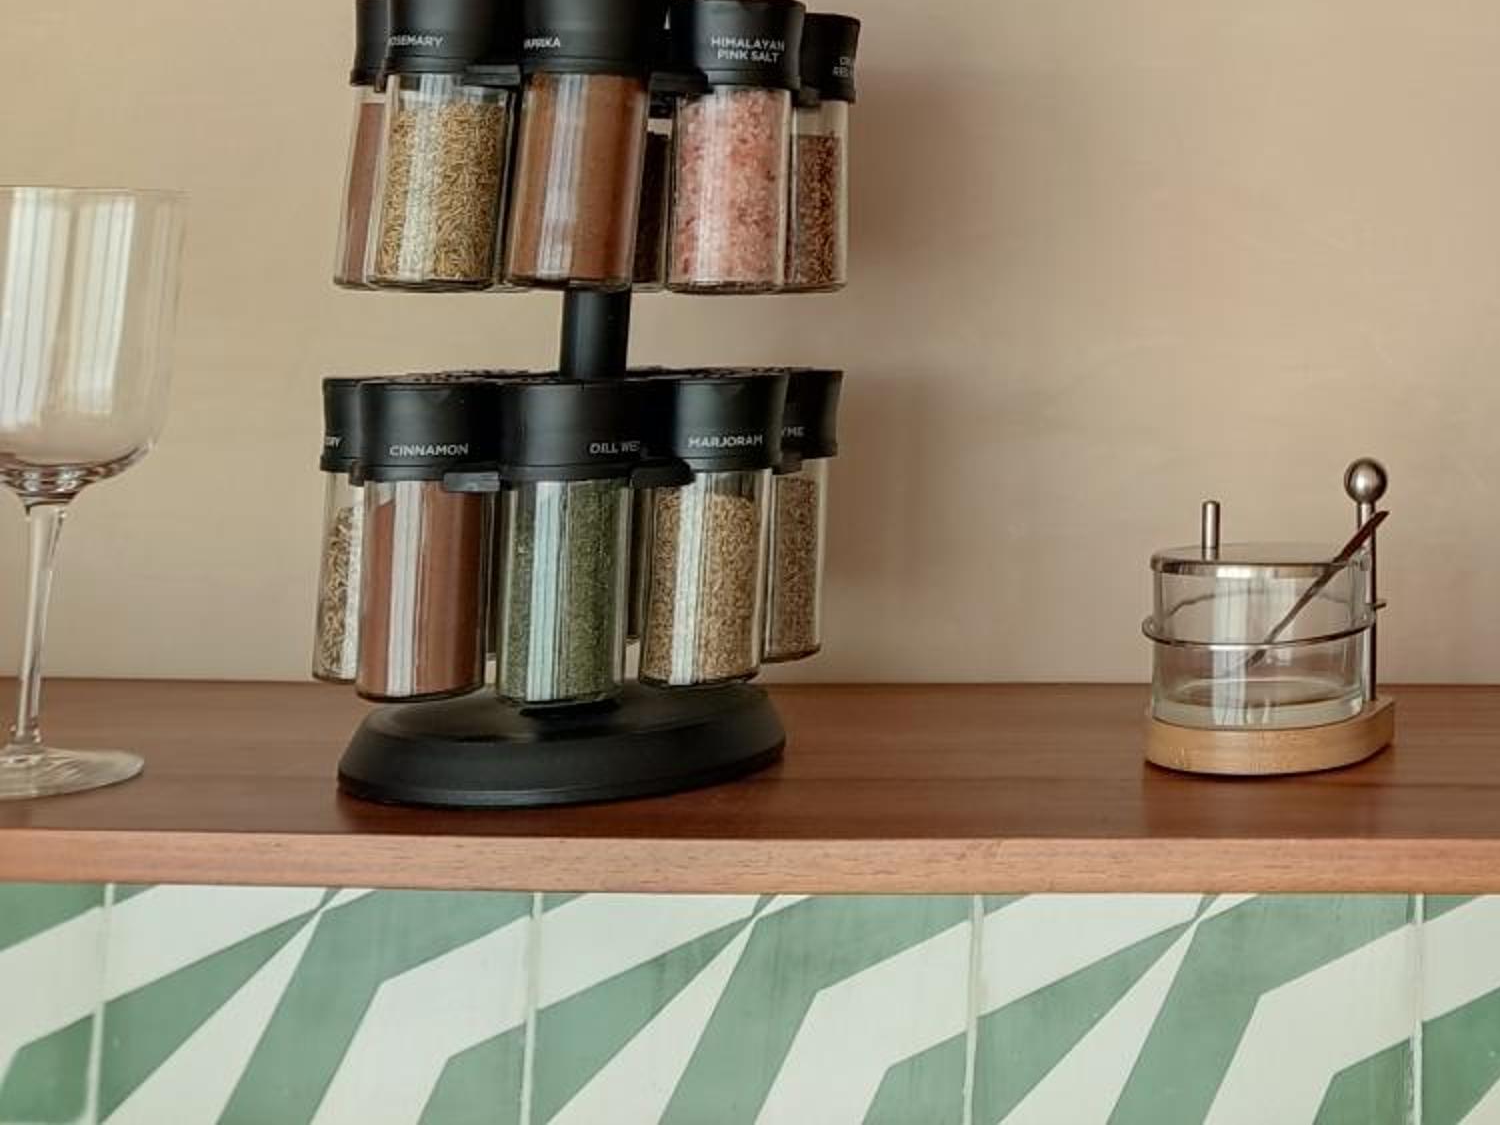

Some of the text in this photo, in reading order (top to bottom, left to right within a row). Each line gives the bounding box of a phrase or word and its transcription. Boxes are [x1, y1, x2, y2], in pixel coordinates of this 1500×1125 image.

[390, 35, 444, 46] OSEMARY
[523, 37, 560, 49] APRIKA
[711, 36, 785, 51] HIMALAYAN
[717, 49, 780, 63] PINK SALT
[781, 426, 804, 437] YME
[590, 442, 618, 454] DILL
[687, 435, 764, 449] MARJORAM
[389, 443, 468, 456] CINNAMON
